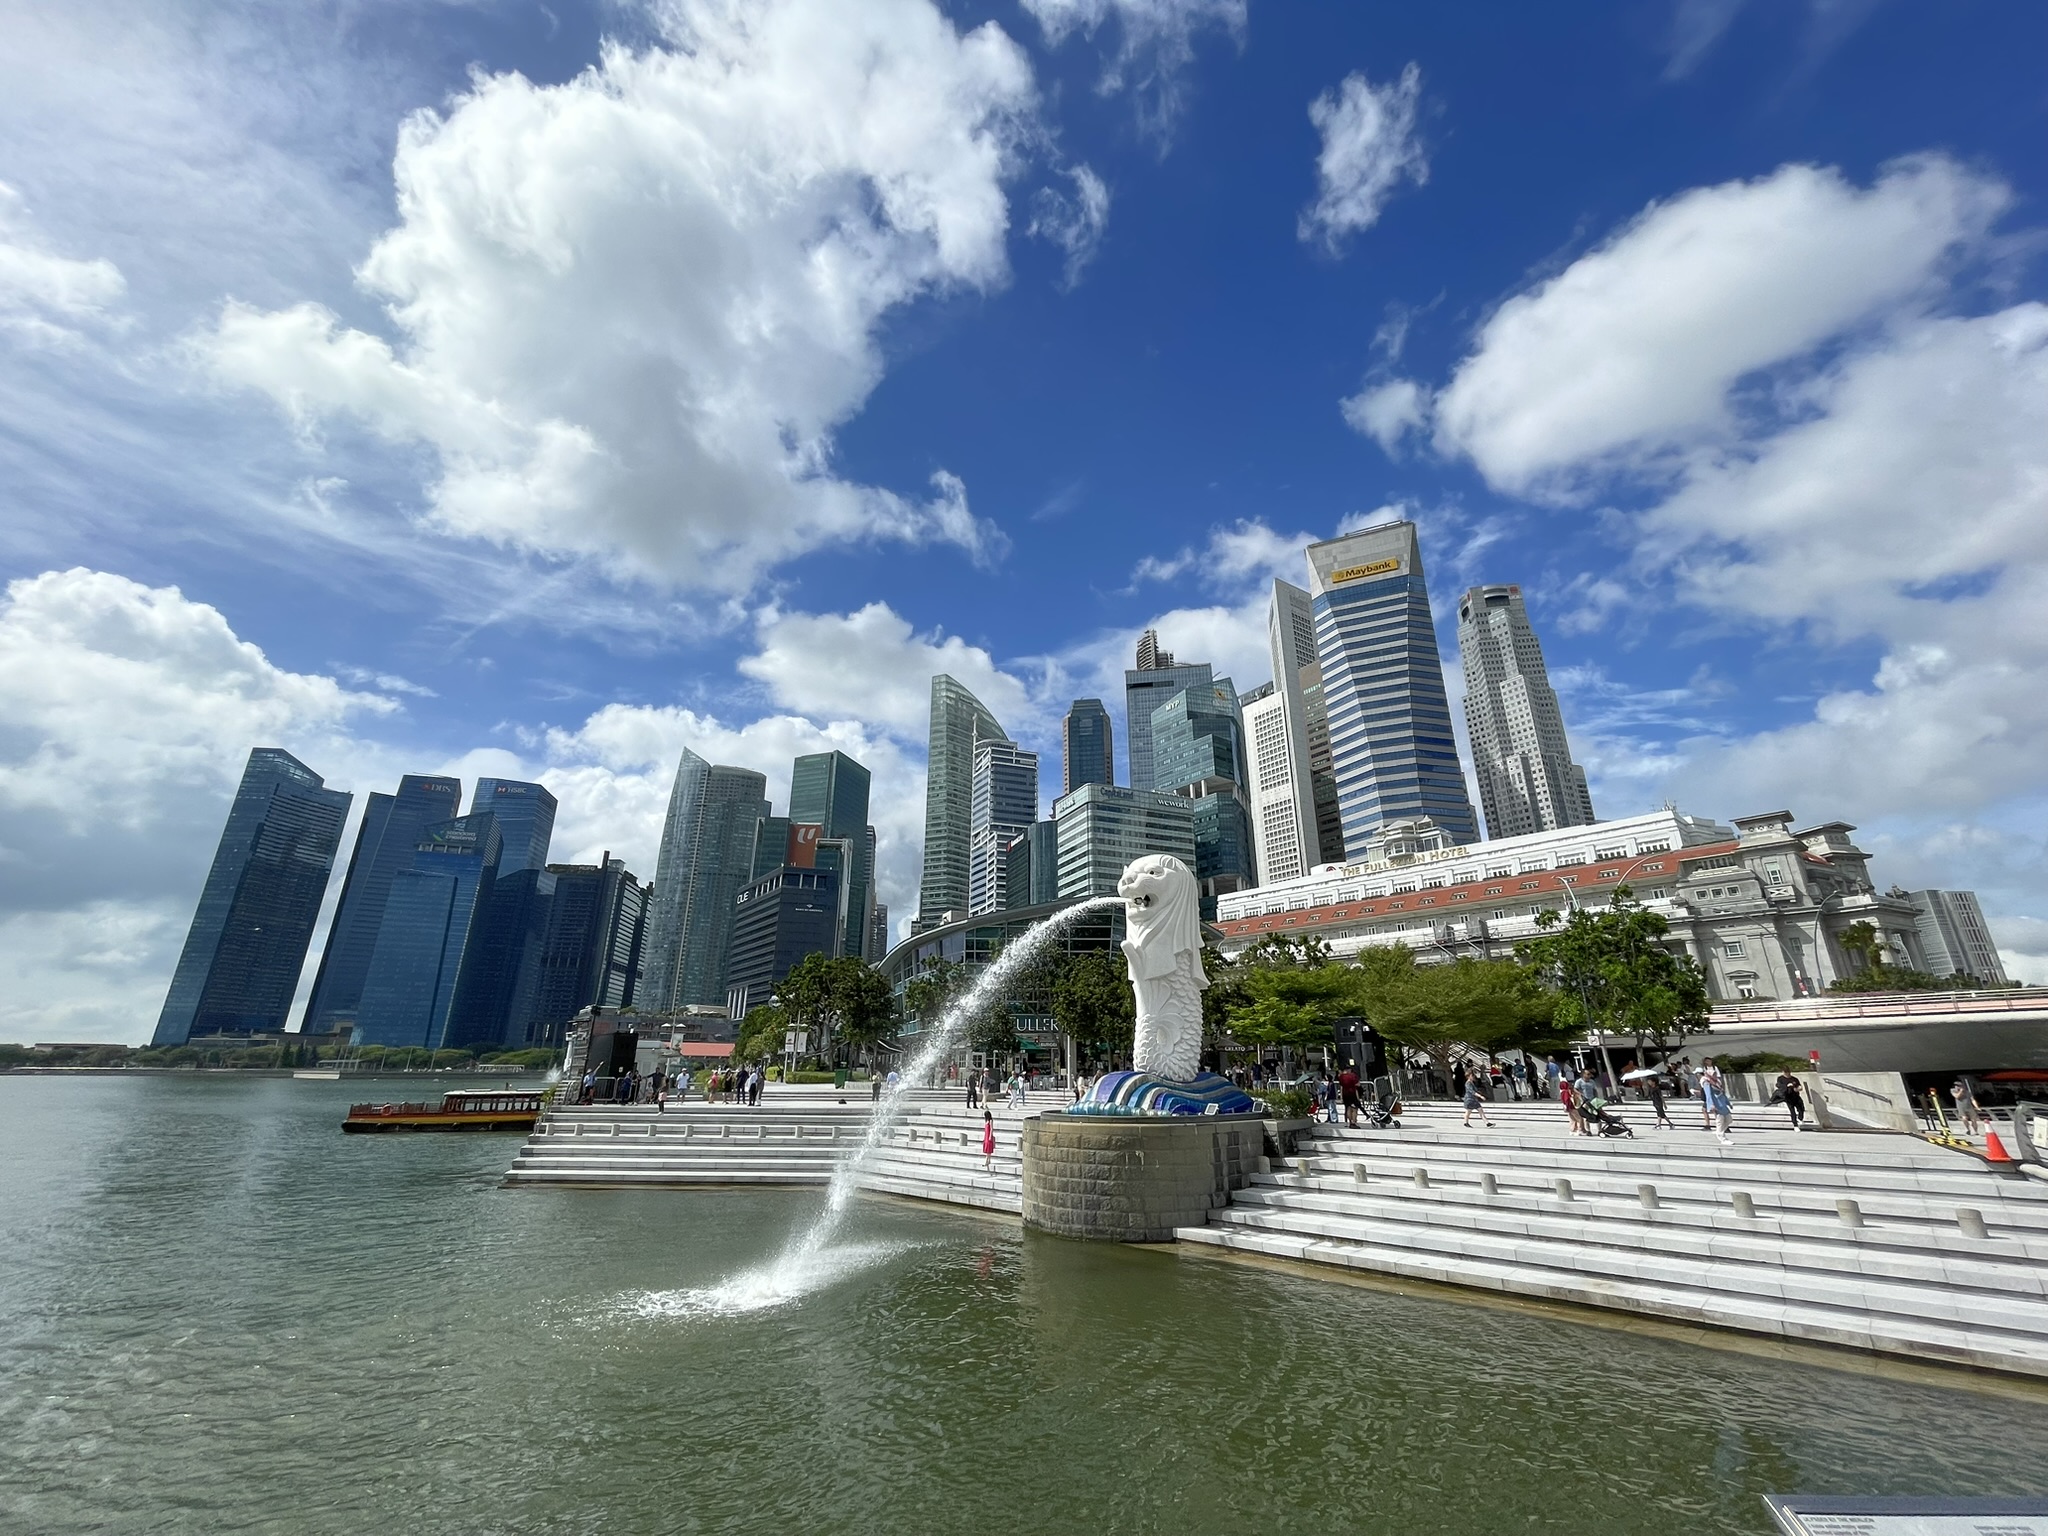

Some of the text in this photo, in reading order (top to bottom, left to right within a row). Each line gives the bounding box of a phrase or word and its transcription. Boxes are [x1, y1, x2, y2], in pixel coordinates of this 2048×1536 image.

[1345, 561, 1391, 577] Maybank
[1165, 700, 1180, 712] MYP
[431, 784, 451, 793] DBS
[1100, 786, 1134, 800] CapitaLand
[1157, 799, 1190, 809] wework
[1341, 846, 1470, 877] THE FULLERTON HOTEL
[736, 891, 750, 905] OUE
